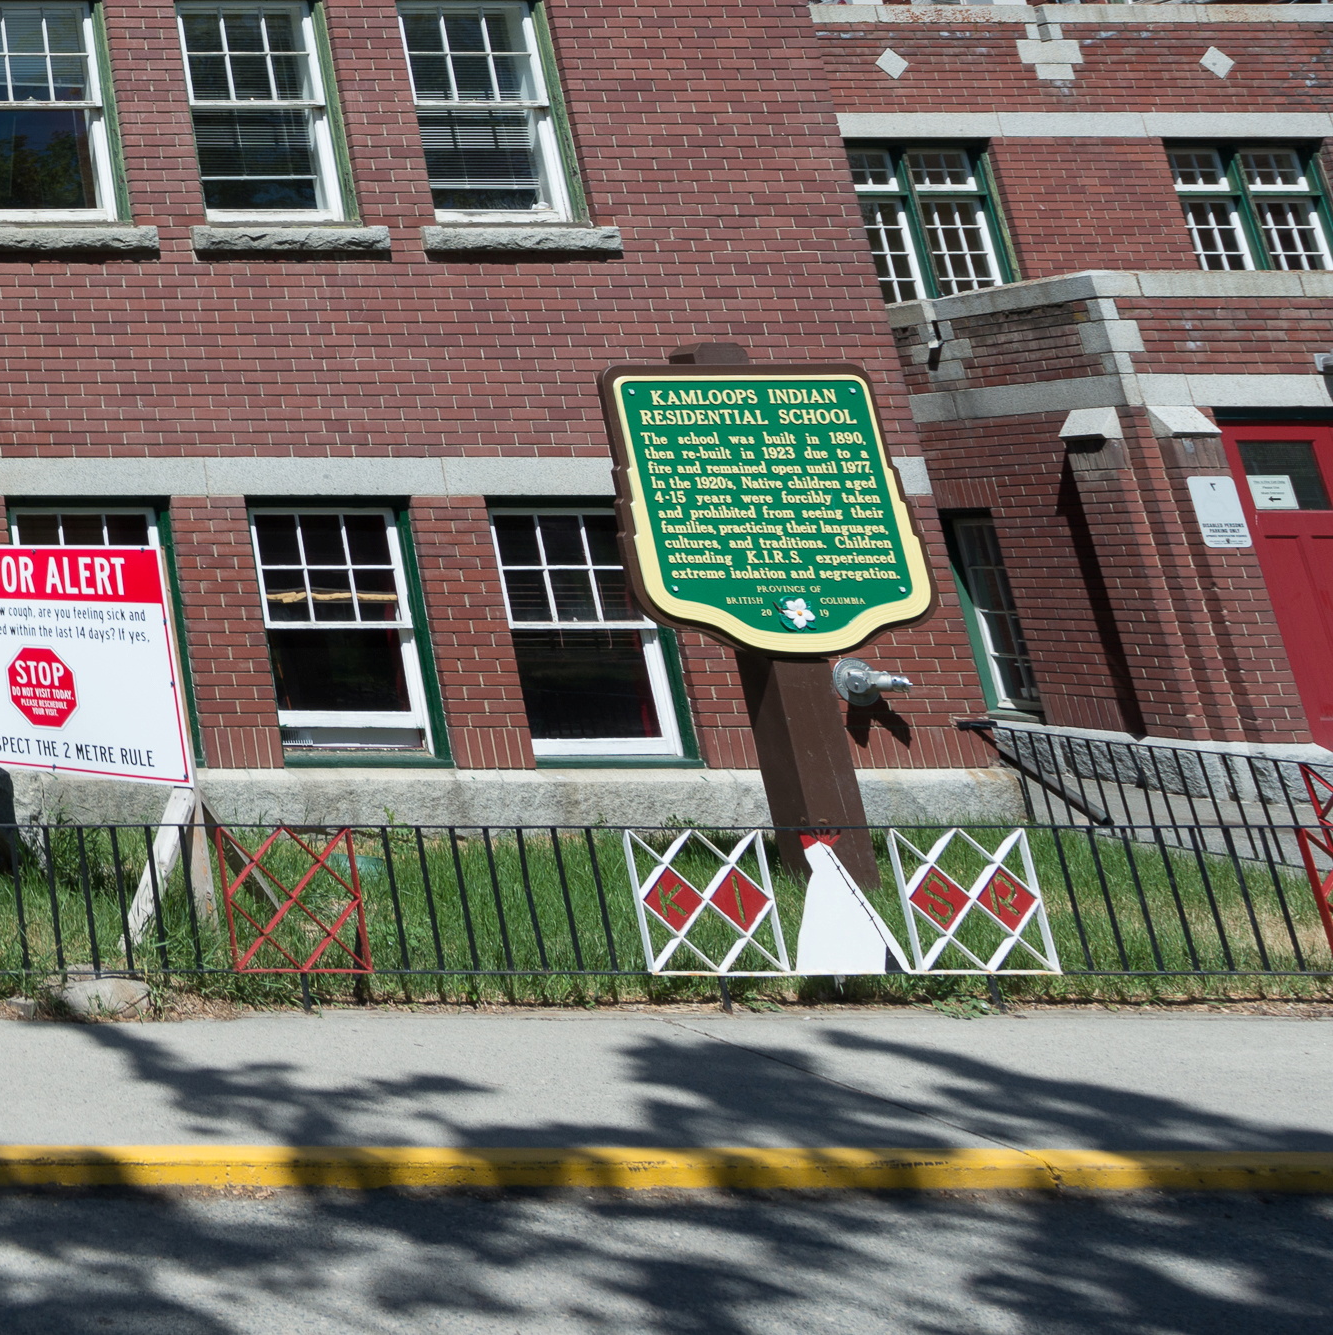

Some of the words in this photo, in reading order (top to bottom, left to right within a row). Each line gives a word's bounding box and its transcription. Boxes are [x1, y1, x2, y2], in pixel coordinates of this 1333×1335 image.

[650, 390, 757, 405] KAMLOOPS
[768, 389, 837, 403] INDIAN
[640, 410, 768, 425] RESIDENTIAL
[779, 409, 857, 424] SCHOOL
[640, 432, 667, 444] The
[678, 432, 719, 444] school
[728, 436, 755, 444] was
[763, 432, 796, 444] built
[805, 433, 819, 444] in
[829, 432, 866, 445] 1890,
[645, 447, 674, 459] then
[682, 447, 732, 459] re-built
[740, 448, 755, 459] in
[762, 447, 795, 459] 1923
[804, 447, 828, 459] due
[837, 449, 850, 458] to
[648, 461, 672, 473] fire
[677, 461, 701, 473] and
[706, 461, 767, 473] remained
[772, 466, 802, 475] open
[806, 461, 837, 473] until
[841, 461, 873, 473] 1977.
[651, 476, 666, 488] In
[669, 476, 691, 488] the
[695, 477, 736, 489] 1920's,
[741, 476, 783, 488] Native
[788, 476, 841, 488] children
[845, 476, 877, 490] aged
[655, 491, 686, 503] 4-15
[695, 495, 732, 505] years
[741, 495, 773, 503] were
[782, 491, 832, 505] forcibly
[842, 491, 881, 503] taken
[658, 506, 683, 518] and
[690, 506, 756, 521] prohibited
[763, 506, 795, 518] from
[802, 507, 843, 520] seeing
[851, 506, 883, 518] their
[661, 521, 716, 534] families,
[719, 522, 783, 535] practicing
[786, 521, 817, 533] their
[819, 521, 888, 536] languages,
[665, 536, 721, 549] cultures,
[729, 536, 753, 548] and
[759, 536, 827, 548] traditions.
[835, 536, 892, 548] Children
[668, 551, 732, 565] attending
[746, 551, 802, 563] K.I.R.S.
[816, 551, 896, 565] experienced
[45, 556, 126, 596] ALERT
[672, 568, 725, 578] extreme
[730, 566, 786, 579] isolation
[791, 566, 815, 578] and
[819, 568, 900, 581] segregation.
[756, 585, 807, 593] PROVINCE
[809, 585, 821, 593] OF
[725, 596, 764, 605] BRITISH
[819, 597, 866, 605] COLUMBIA
[9, 607, 35, 620] cough,
[38, 609, 51, 618] are
[56, 609, 70, 621] you
[73, 607, 103, 623] feeling
[107, 608, 125, 621] sick
[129, 609, 146, 622] and
[761, 608, 773, 617] 20
[819, 609, 830, 618] 19
[10, 624, 36, 636] within
[39, 626, 52, 637] the
[56, 626, 72, 638] last
[75, 626, 85, 638] 14
[88, 628, 115, 643] days?
[119, 628, 125, 640] If
[129, 630, 150, 644] yes,
[15, 660, 64, 686] STOP
[12, 686, 20, 696] DO
[22, 687, 34, 697] NOT
[35, 688, 51, 698] VISIT
[52, 689, 74, 700] TODAY.
[21, 699, 38, 707] PLEASE
[39, 700, 67, 709] RESCHEDULE
[35, 739, 59, 758] THE
[63, 742, 72, 759] 2
[76, 743, 116, 764] METRE
[120, 747, 155, 767] RULE
